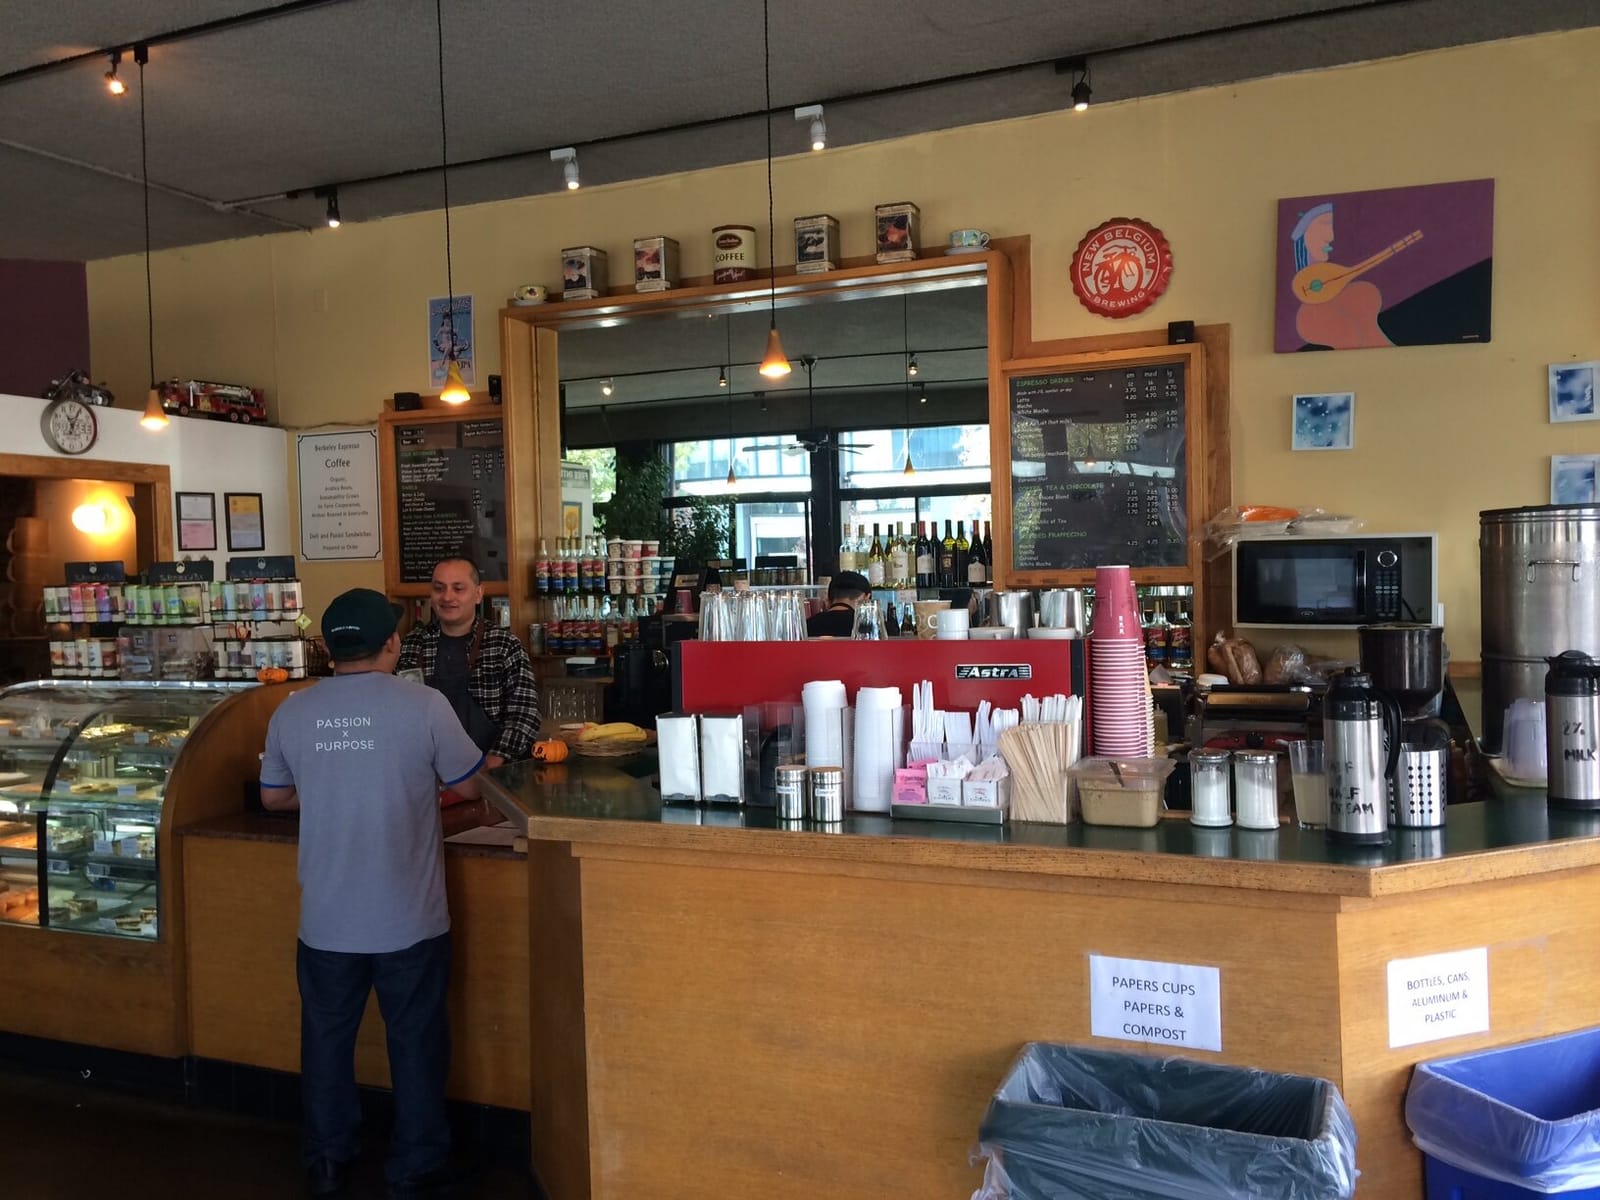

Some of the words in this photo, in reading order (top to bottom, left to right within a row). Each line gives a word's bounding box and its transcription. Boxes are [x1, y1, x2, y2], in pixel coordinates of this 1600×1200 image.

[715, 252, 745, 263] COFFEE
[1082, 241, 1101, 272] NEW
[1105, 230, 1156, 265] BELGIUM
[1094, 290, 1146, 308] BREWING
[1016, 378, 1048, 387] ESPRESSO
[1049, 377, 1075, 385] DRINKS
[338, 442, 360, 450] Espresso
[325, 458, 351, 468] Coffee
[316, 716, 371, 729] PASSION
[1563, 720, 1585, 736] 2%
[315, 740, 375, 752] PURPOSE
[1564, 748, 1596, 762] MILK
[1112, 976, 1159, 993] PAPERS
[1162, 982, 1196, 996] CUPS
[1412, 991, 1460, 1007] ALUMINUM
[1462, 989, 1468, 999] &
[1124, 1000, 1171, 1017] PAPERS
[1174, 1006, 1184, 1018] &
[1425, 1009, 1456, 1023] PLASTIC
[1123, 1023, 1187, 1041] COMPOST
